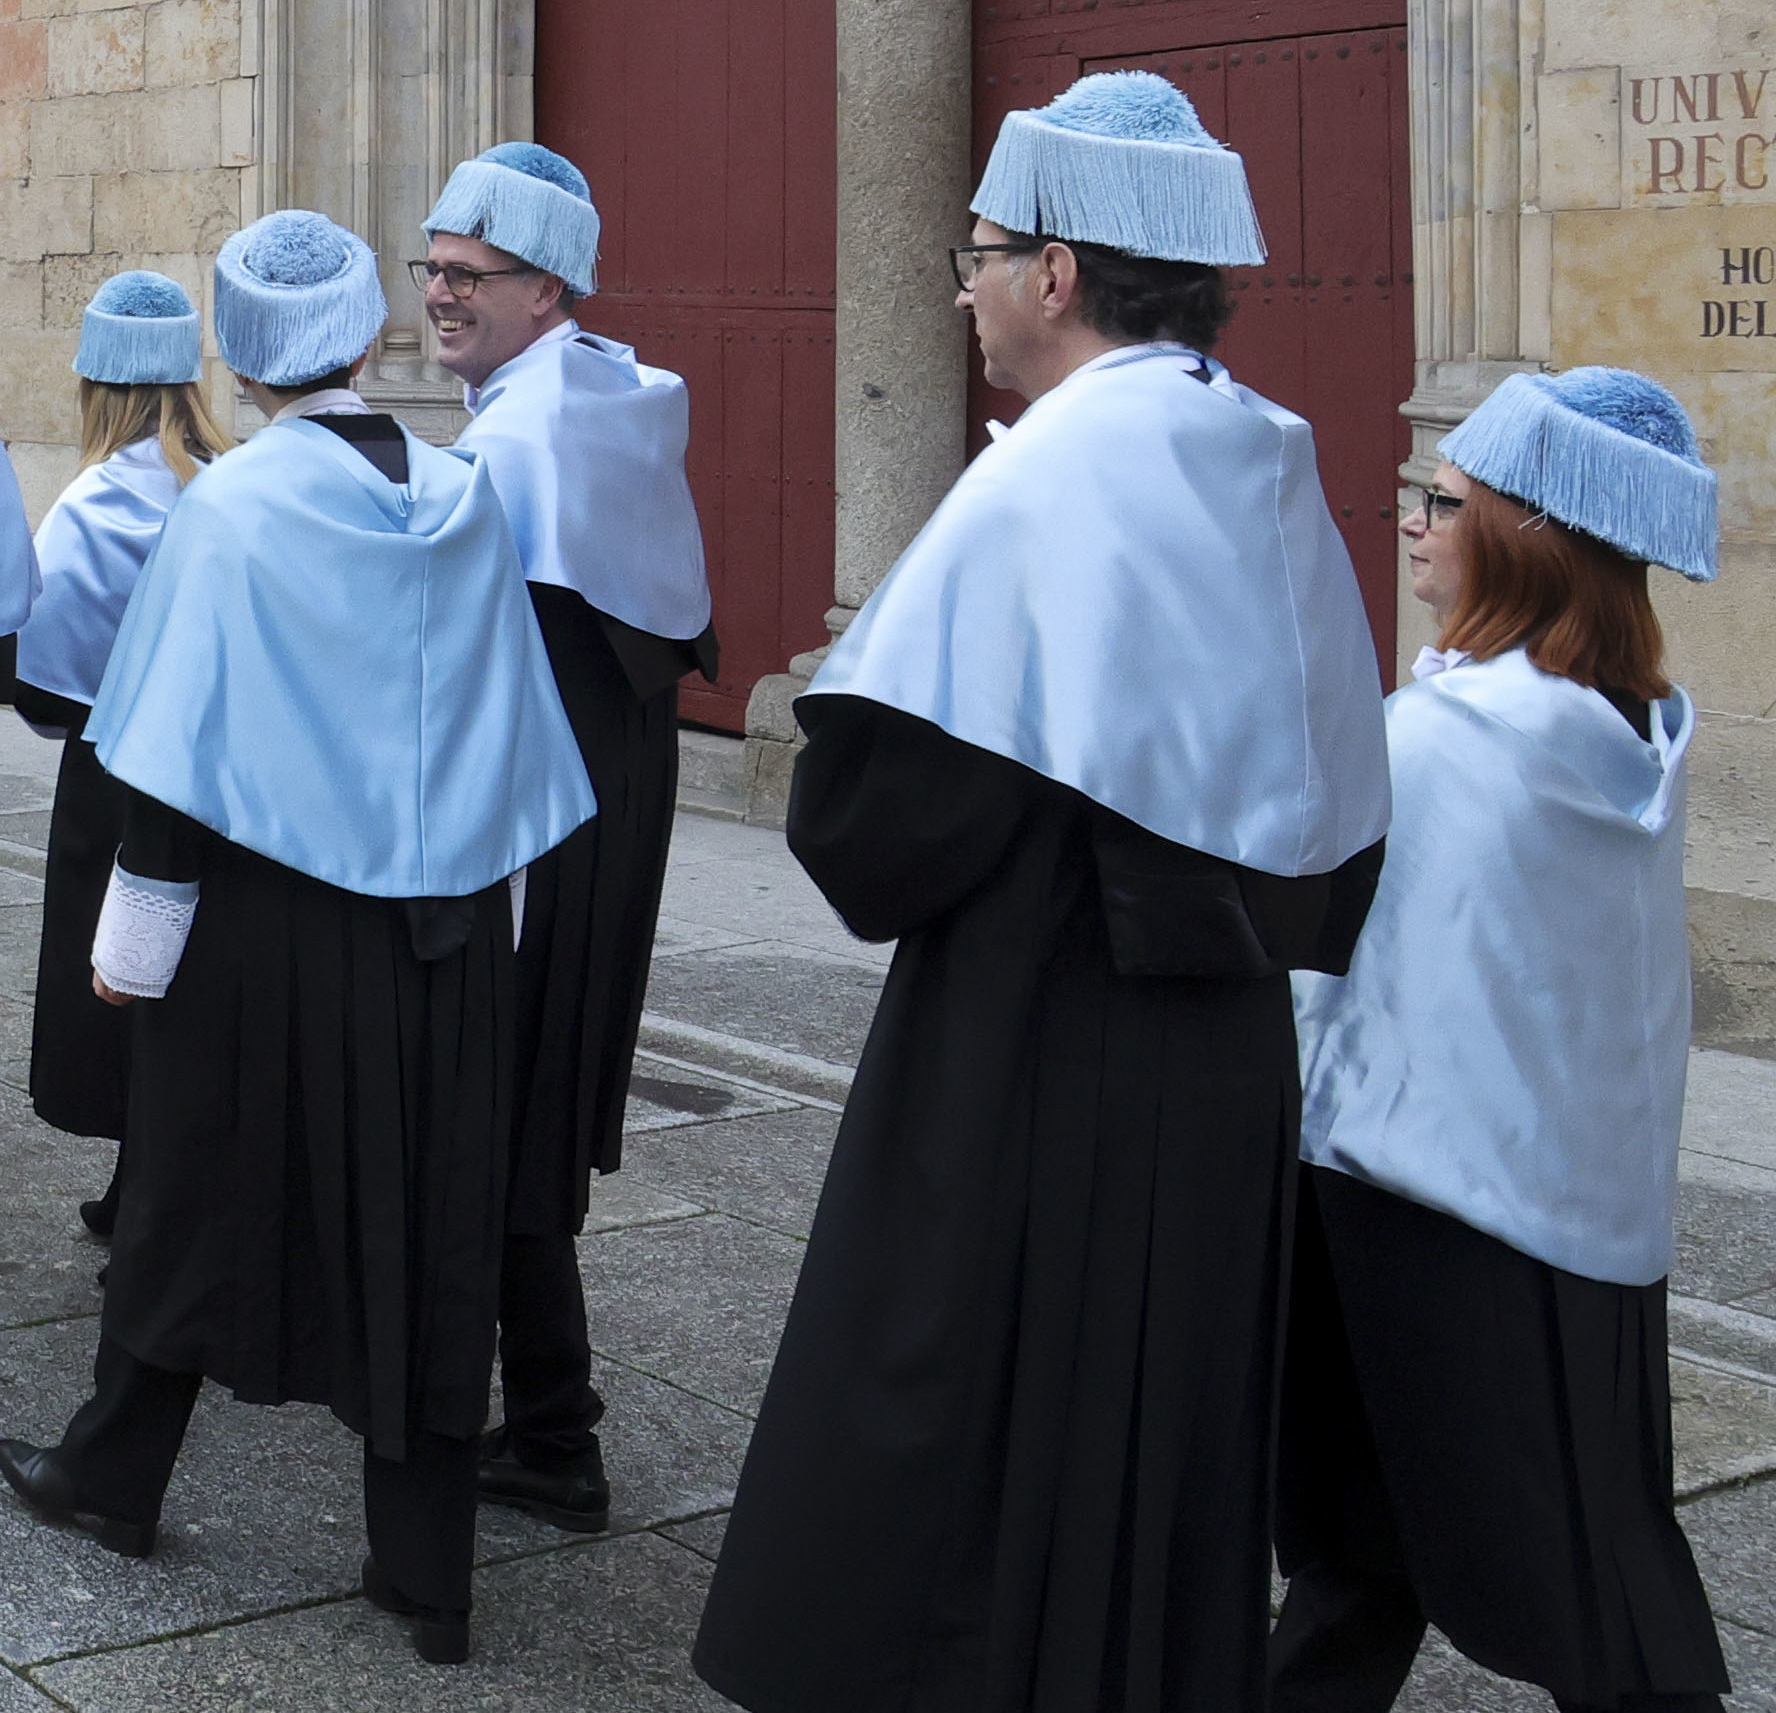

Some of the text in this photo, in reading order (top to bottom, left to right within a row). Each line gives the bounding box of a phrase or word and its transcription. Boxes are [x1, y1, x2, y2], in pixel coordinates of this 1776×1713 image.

[1629, 69, 1776, 125] UNIV
[1646, 132, 1776, 194] REC
[1718, 246, 1776, 285] HO
